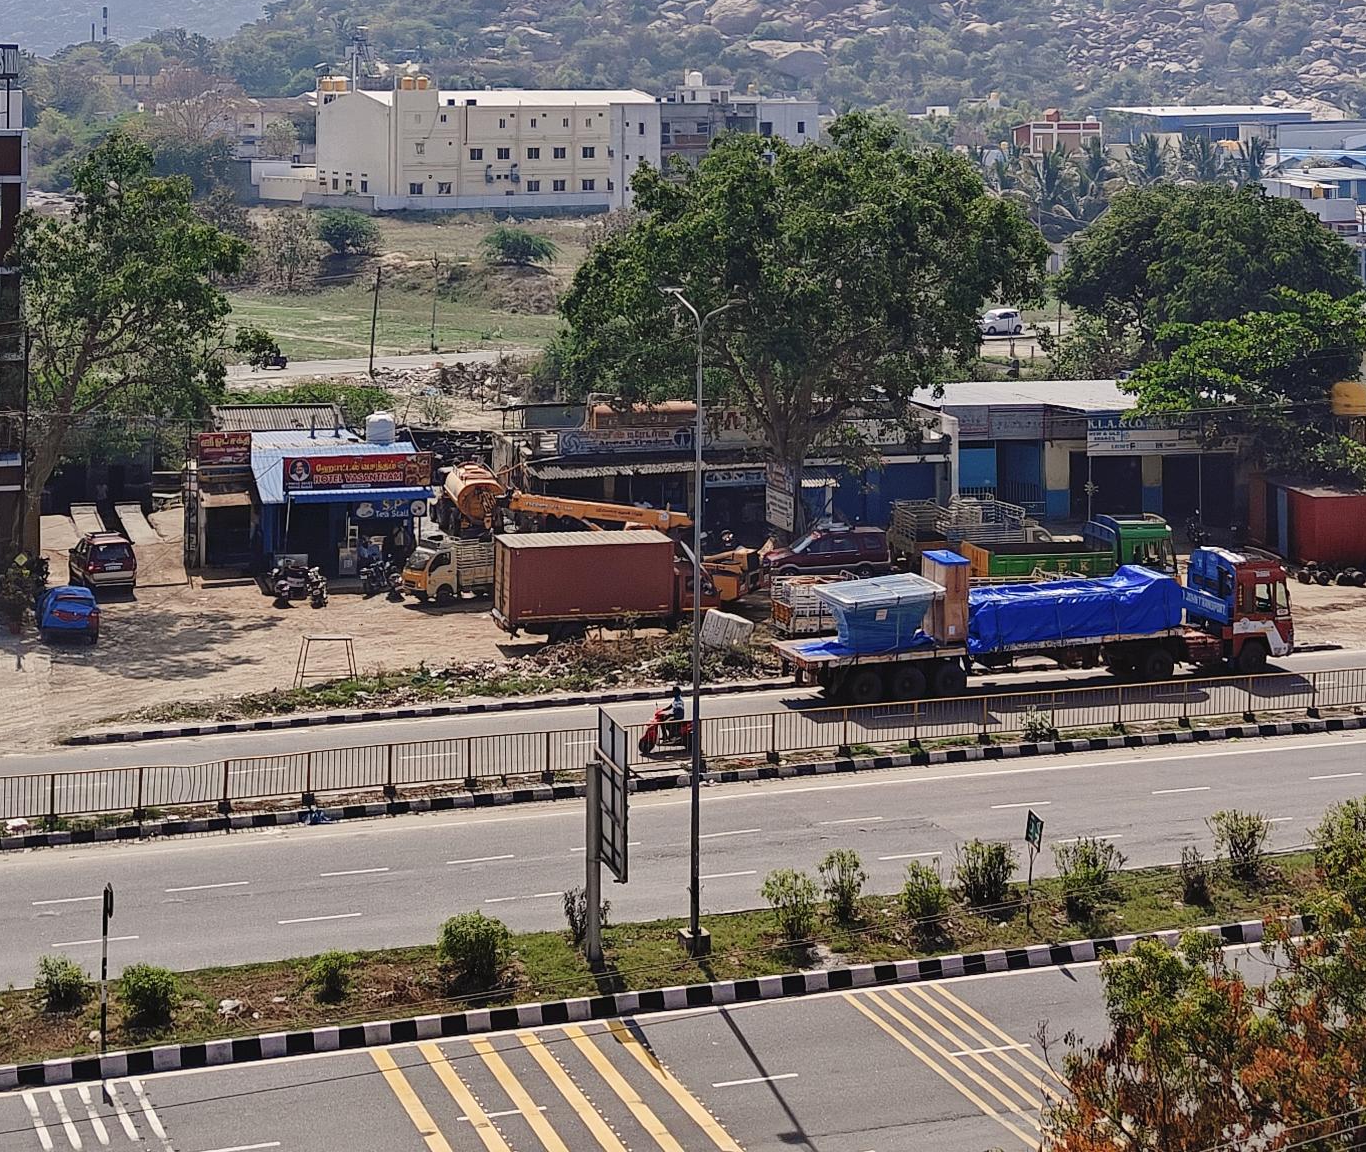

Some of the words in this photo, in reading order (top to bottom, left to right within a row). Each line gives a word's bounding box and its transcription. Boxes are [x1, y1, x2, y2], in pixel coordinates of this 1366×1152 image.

[313, 473, 344, 484] HOTEL
[344, 472, 404, 483] VASANTHAM
[376, 510, 390, 518] Tea
